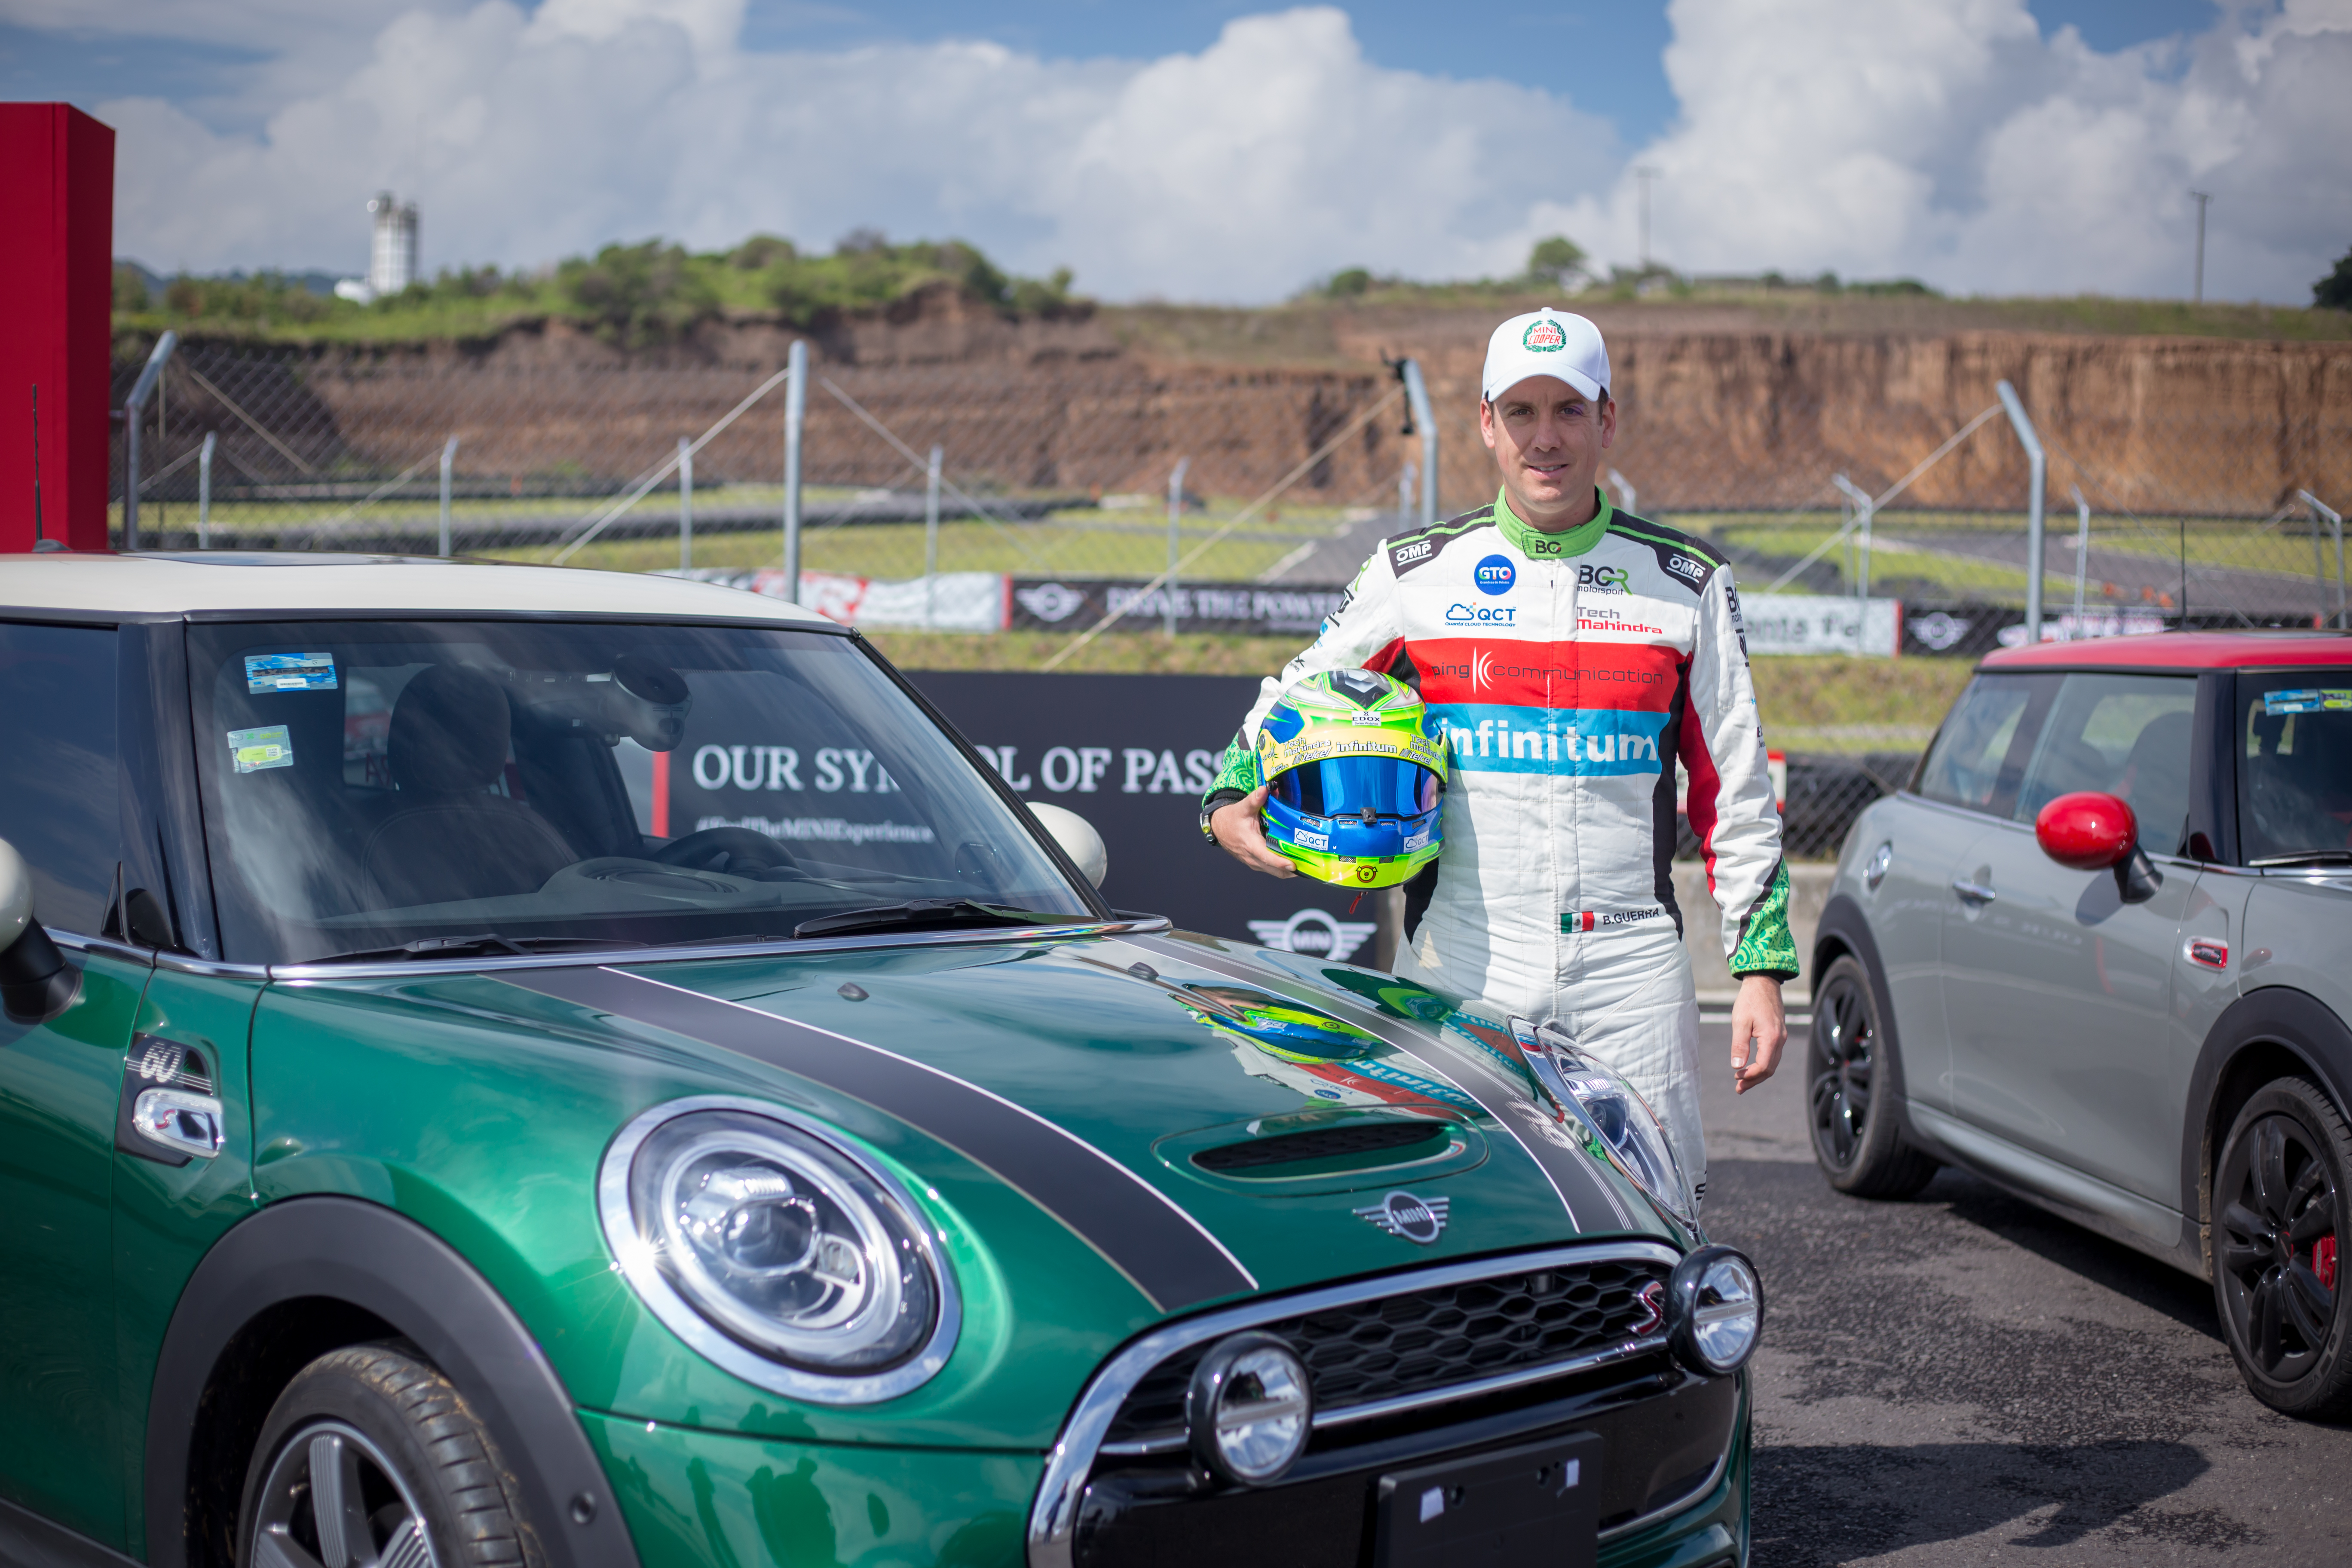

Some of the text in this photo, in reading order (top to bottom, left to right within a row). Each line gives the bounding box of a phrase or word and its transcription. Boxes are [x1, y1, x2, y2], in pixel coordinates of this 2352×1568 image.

[1528, 334, 1561, 345] COOPER
[1396, 542, 1432, 562] OMP
[1479, 567, 1511, 580] GTO
[1669, 557, 1704, 578] OMP
[1577, 585, 1624, 595] motorsport
[1477, 608, 1516, 621] QCT
[1577, 606, 1620, 619] Tech
[1577, 619, 1663, 634] Mahindra
[1431, 662, 1663, 684] ping communication
[1283, 737, 1306, 750] Tech
[1336, 740, 1397, 753] infinitum
[1410, 734, 1430, 748] Tech
[1284, 740, 1331, 758] Mahindra
[1302, 747, 1333, 762] telcel
[1410, 741, 1442, 763] Mahindra
[1409, 750, 1433, 766] telcel
[692, 744, 805, 790] OUR
[1040, 746, 1112, 793] OF
[1309, 837, 1327, 847] QCT
[1418, 835, 1428, 845] QCT
[1603, 908, 1660, 925] B.GUERRA
[140, 1042, 181, 1083] 60
[1392, 1206, 1431, 1224] MINI
